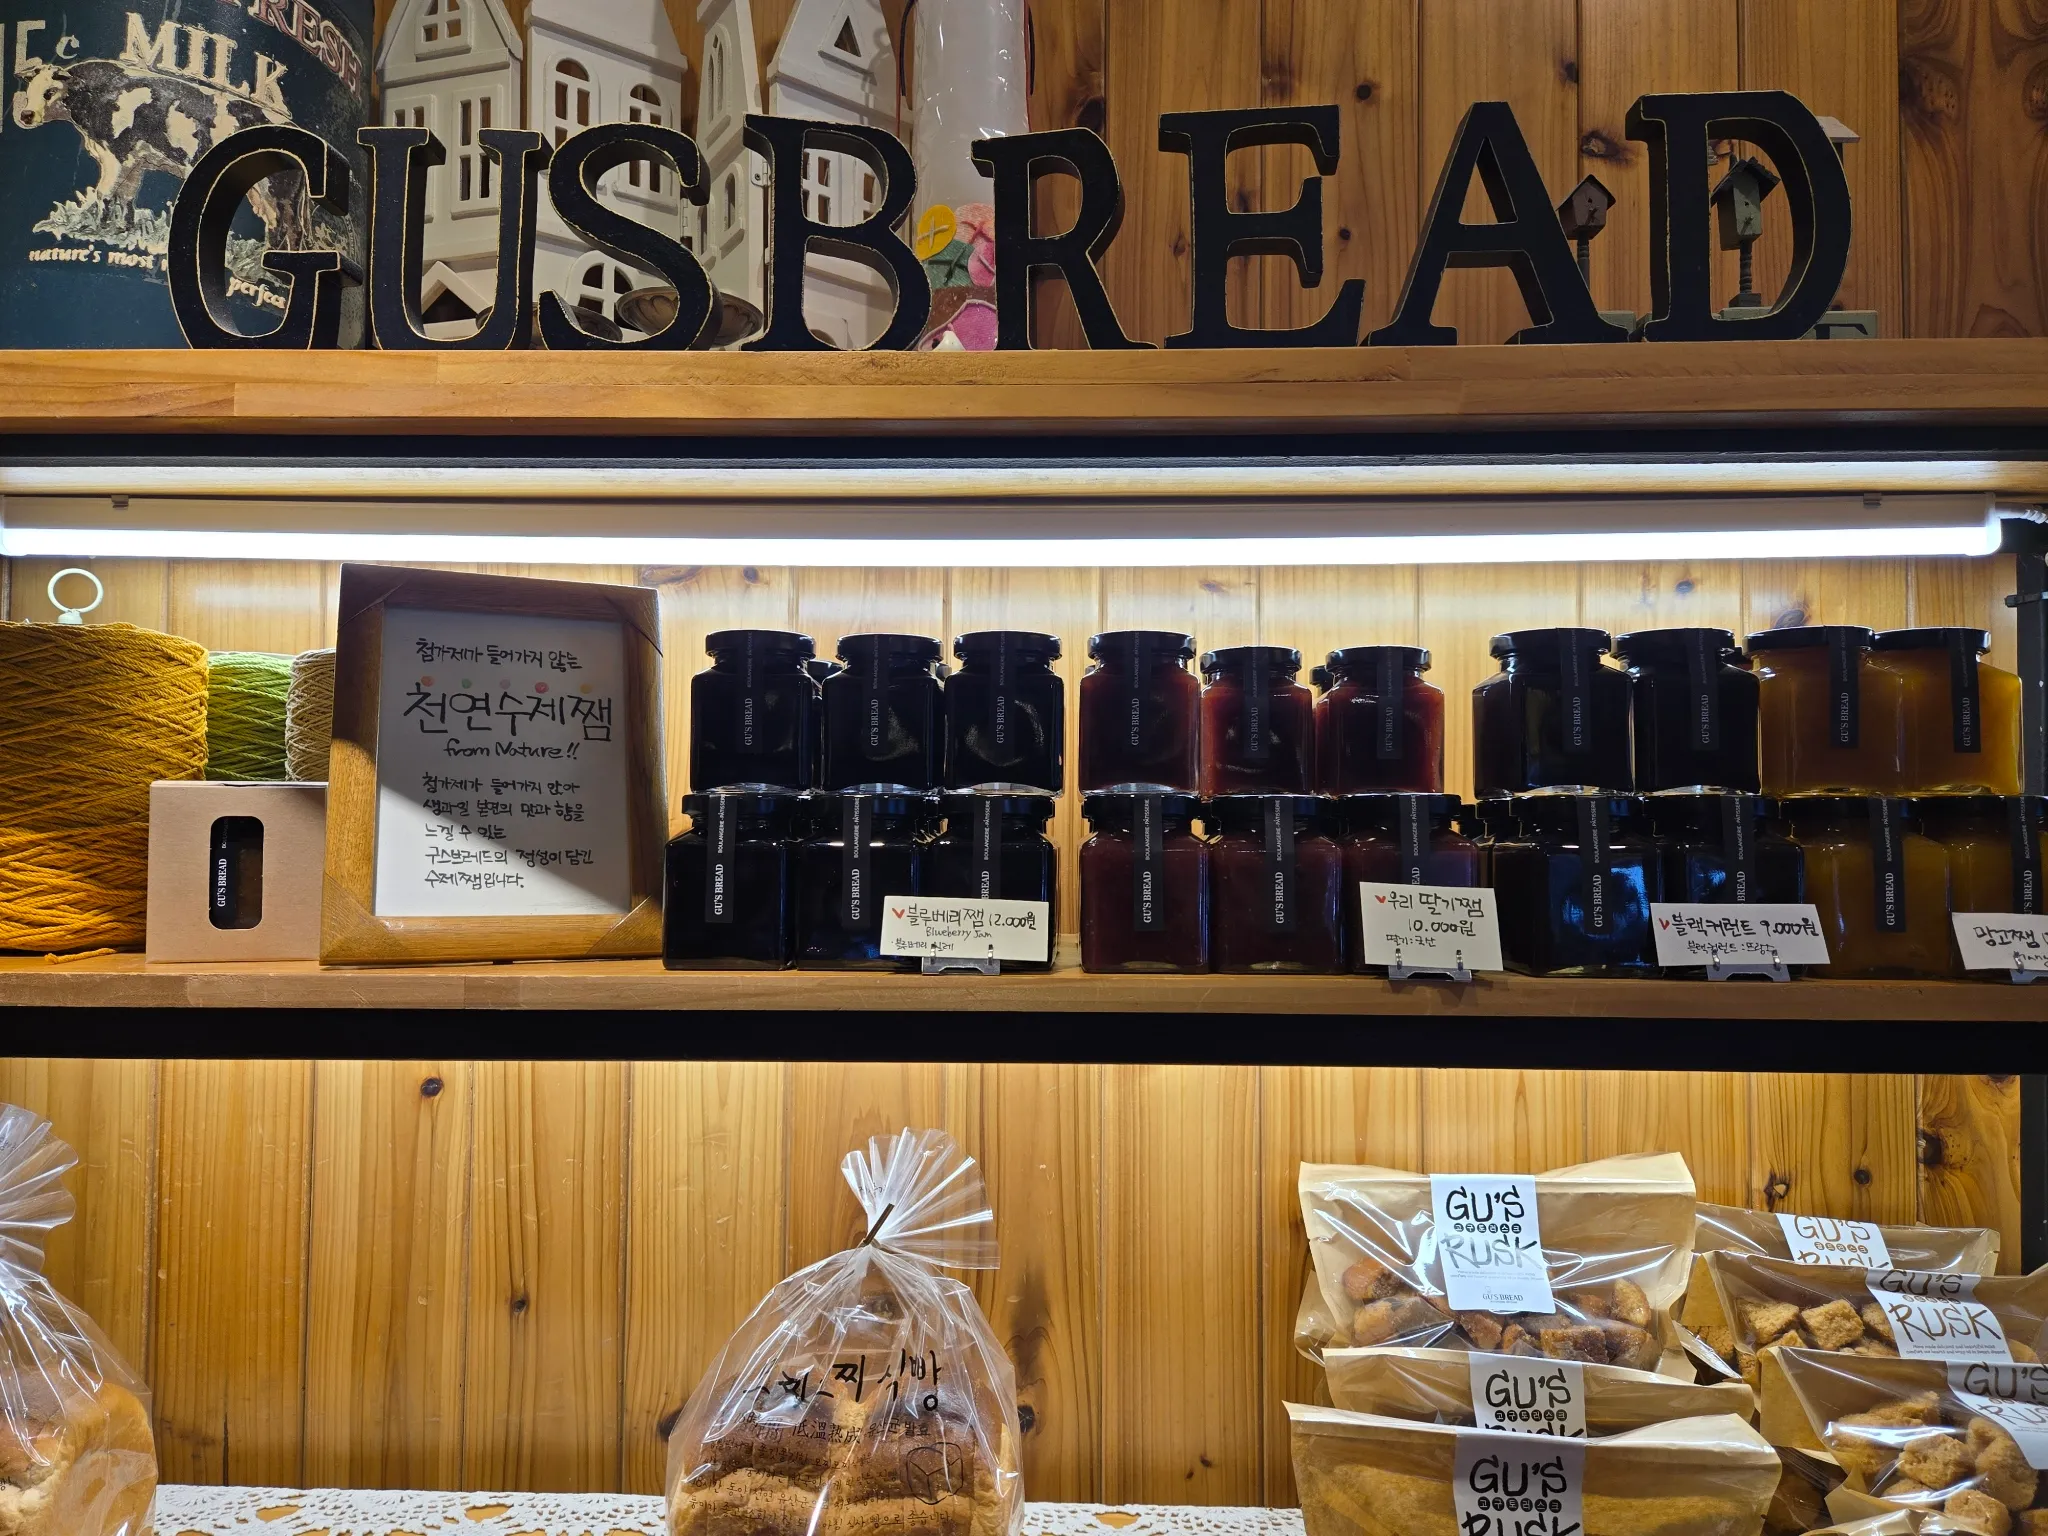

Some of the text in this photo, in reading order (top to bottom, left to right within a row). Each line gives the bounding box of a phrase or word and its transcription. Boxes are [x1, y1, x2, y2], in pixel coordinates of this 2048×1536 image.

[119, 12, 293, 119] MILK
[29, 244, 101, 263] nature's
[107, 251, 153, 270] most
[415, 637, 583, 673] 첨가제가 들어가지 않는
[996, 724, 1004, 743] GU'S
[1573, 697, 1581, 746] GU'S BREAD
[1701, 695, 1710, 743] GU'S BREAD
[1840, 723, 1849, 742] GU'S
[1962, 698, 1971, 746] GU'S BREAD
[443, 738, 490, 758] from
[744, 726, 753, 746] GU'S
[1131, 727, 1139, 746] GU'S
[1385, 734, 1393, 751] GU'S
[422, 772, 483, 794] 첨가제가
[490, 778, 543, 795] 들어가지
[423, 799, 470, 817] 생과일
[520, 803, 551, 818] 맛과
[554, 801, 585, 822] 향을
[459, 824, 472, 841] 수
[477, 824, 507, 840] 있는
[1592, 829, 1600, 863] BOULANGERIE
[425, 846, 594, 868] 구스브레드의 정성이 담긴
[217, 858, 227, 886] BREAD
[981, 871, 989, 899] BREAD
[1412, 867, 1420, 885] EAD
[1737, 871, 1745, 901] BREAD
[2024, 870, 2032, 900] BREAD
[217, 887, 226, 907] GU'S
[714, 864, 723, 915] GU'S BREAD
[851, 869, 860, 919] GU'S BREAD
[1142, 871, 1151, 923] GU'S BREAD
[1275, 872, 1284, 923] GU'S BREAD
[1388, 891, 1413, 910] 우리
[1593, 875, 1603, 927] GU'S BREAD
[1885, 873, 1895, 925] GU'S BREAD
[925, 927, 993, 941] Blueberry Jam
[1408, 918, 1476, 937] 10.000원
[1671, 912, 1757, 937] 블랙커런트
[1445, 1185, 1525, 1224] GU'S
[1439, 1234, 1541, 1270] RUSK
[1879, 1268, 1964, 1297] GU'S
[1888, 1302, 2002, 1343] RUSK
[1485, 1368, 1572, 1410] GU'S
[1469, 1455, 1568, 1498] GU'S
